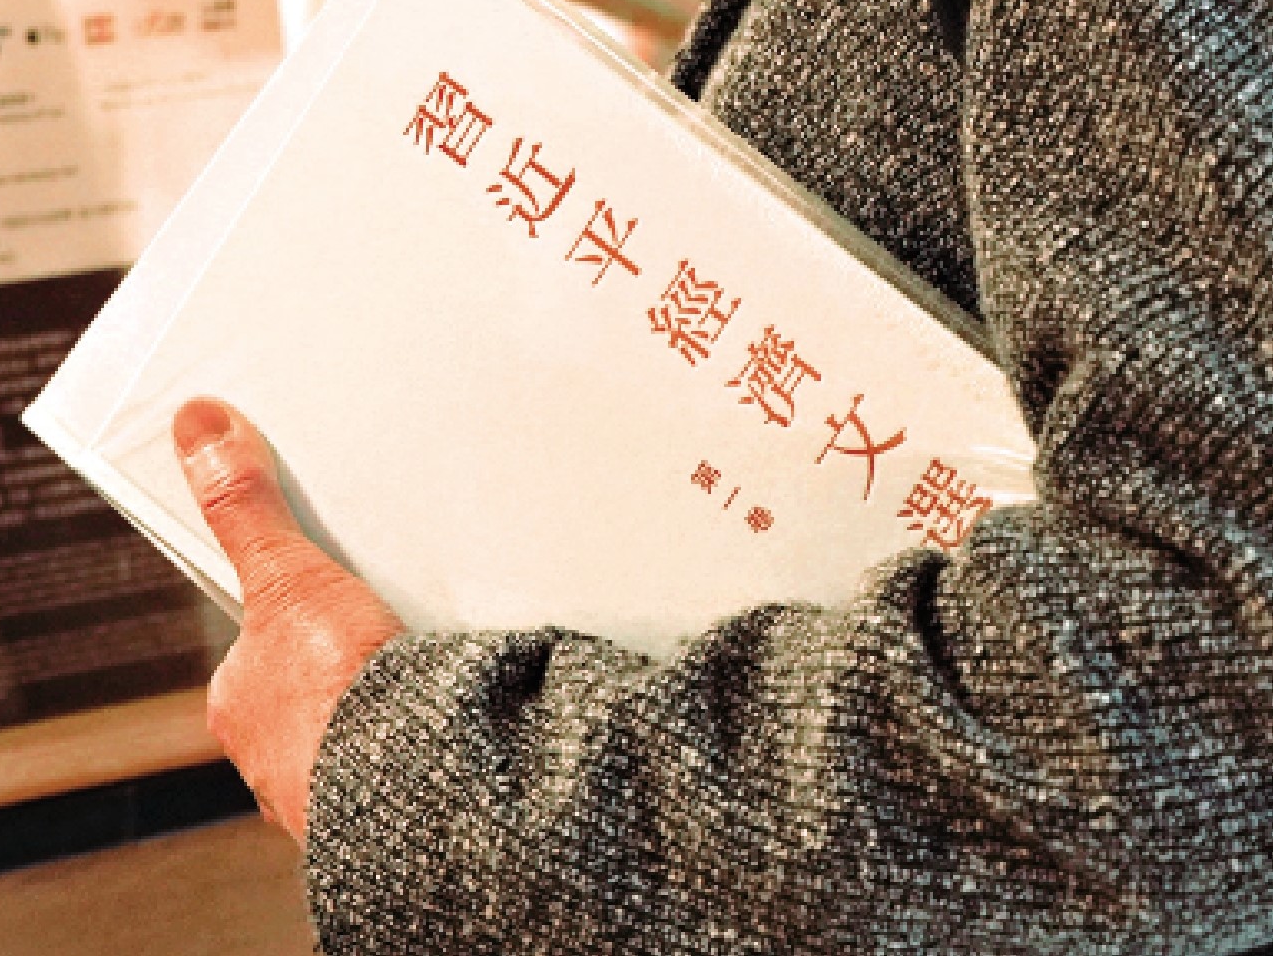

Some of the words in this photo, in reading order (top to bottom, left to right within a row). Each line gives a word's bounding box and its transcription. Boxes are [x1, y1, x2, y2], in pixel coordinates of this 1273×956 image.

[403, 71, 993, 549] 習近平經濟文選
